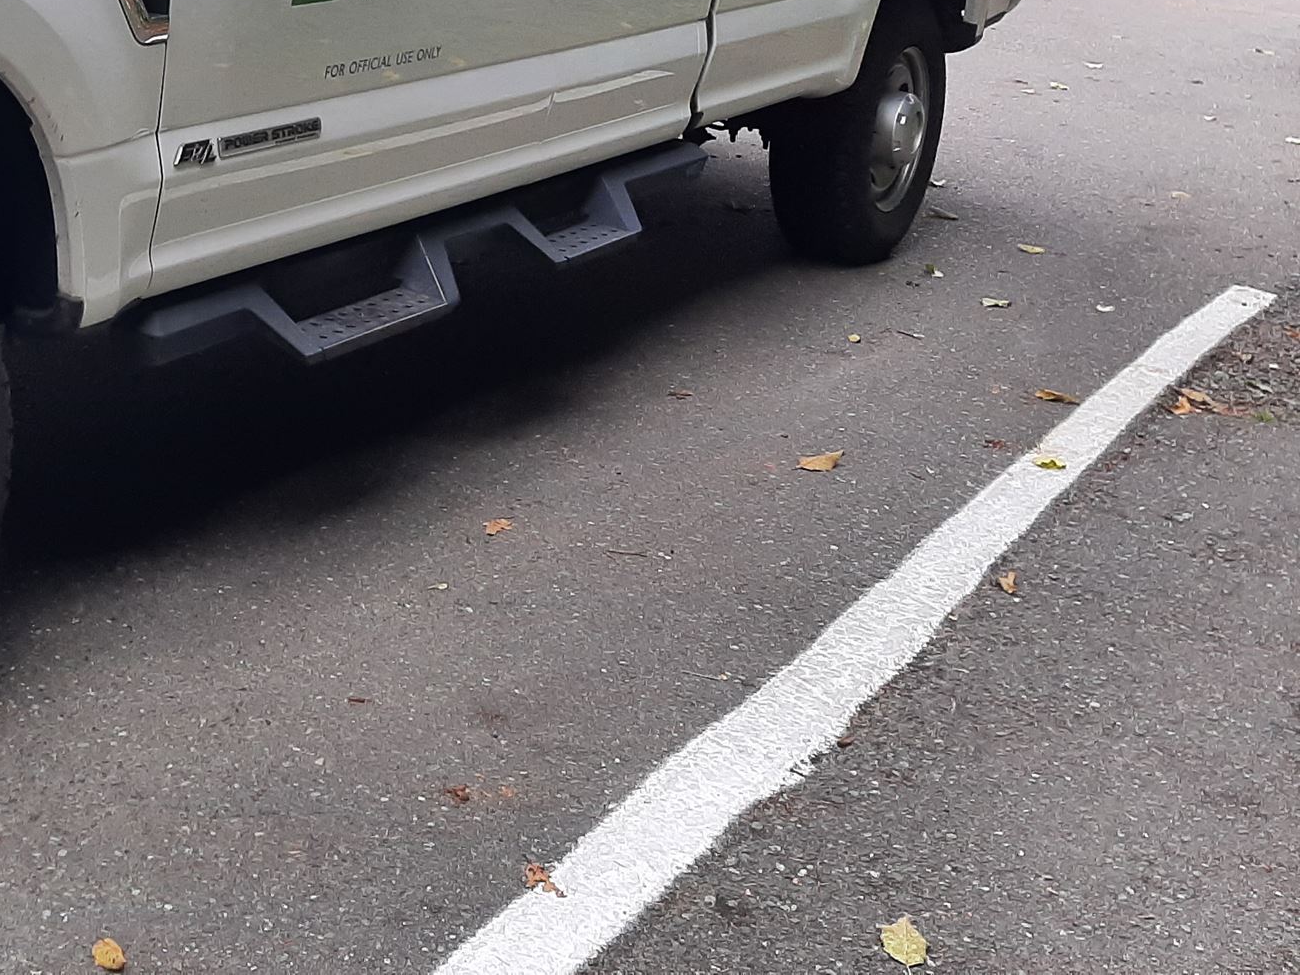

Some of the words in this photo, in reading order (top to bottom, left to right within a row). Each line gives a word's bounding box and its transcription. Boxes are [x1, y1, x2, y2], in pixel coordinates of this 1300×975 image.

[324, 63, 345, 79] FOR
[348, 55, 391, 74] OFFICIAL
[396, 50, 415, 66] USE
[417, 45, 442, 61] ONLY
[224, 131, 269, 150] POWER
[271, 120, 320, 140] STROKE
